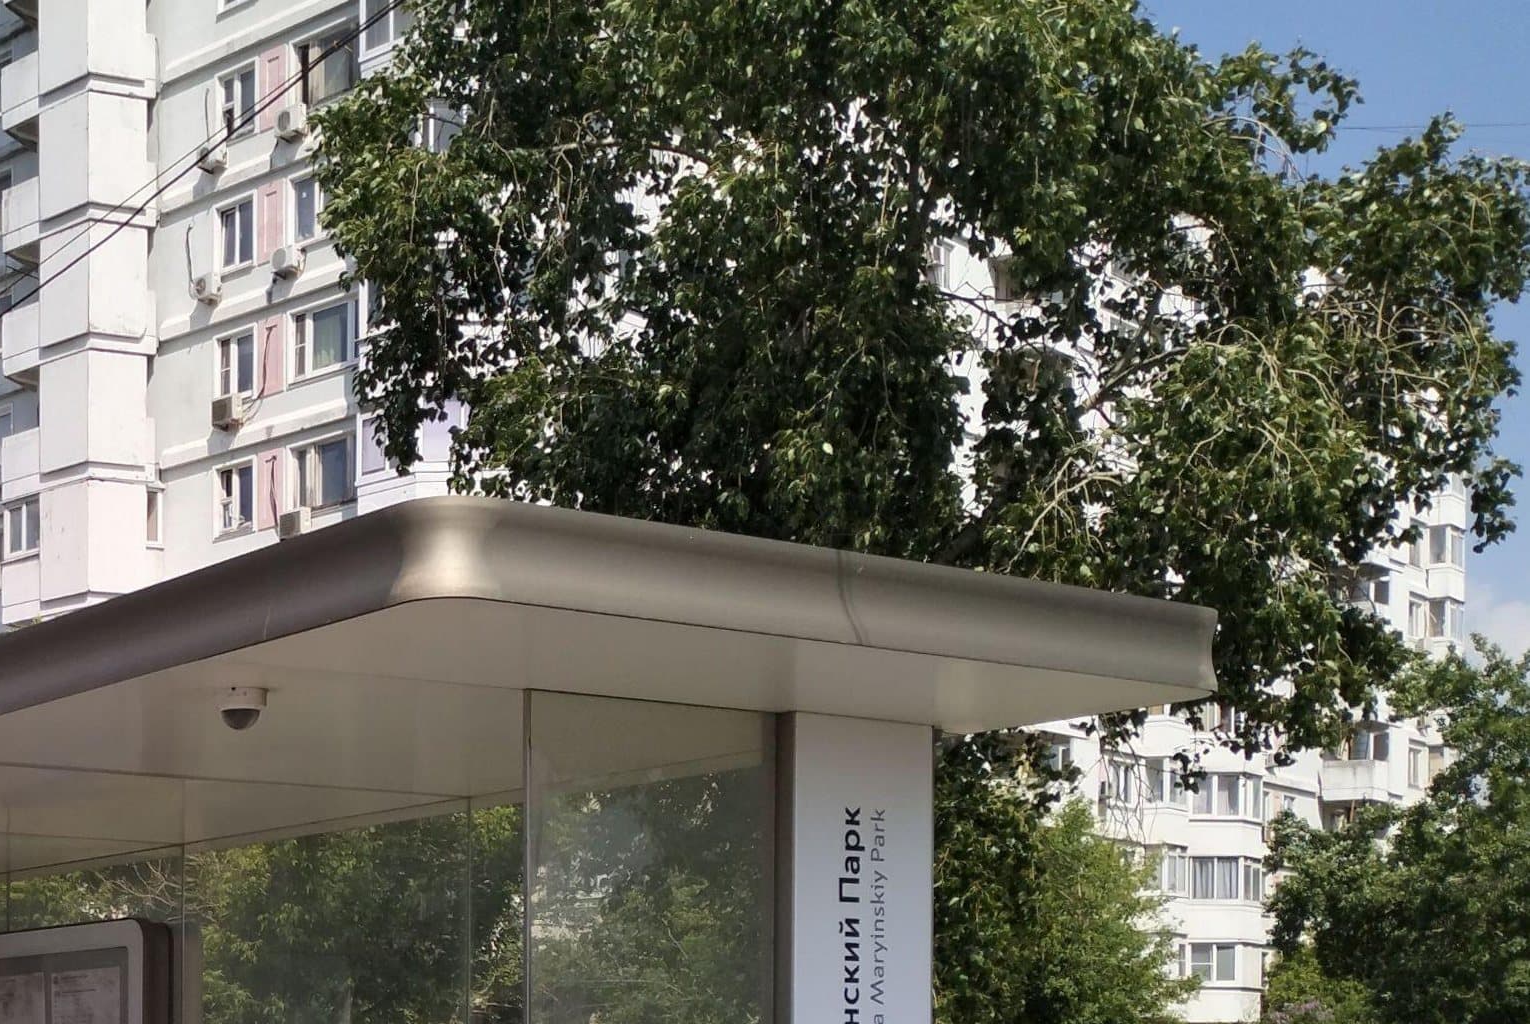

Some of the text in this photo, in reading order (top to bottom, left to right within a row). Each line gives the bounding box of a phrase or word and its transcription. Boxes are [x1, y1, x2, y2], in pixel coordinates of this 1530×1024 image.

[839, 807, 866, 903] Парк
[870, 809, 886, 862] Park
[870, 870, 888, 1005] Maryinskiy
